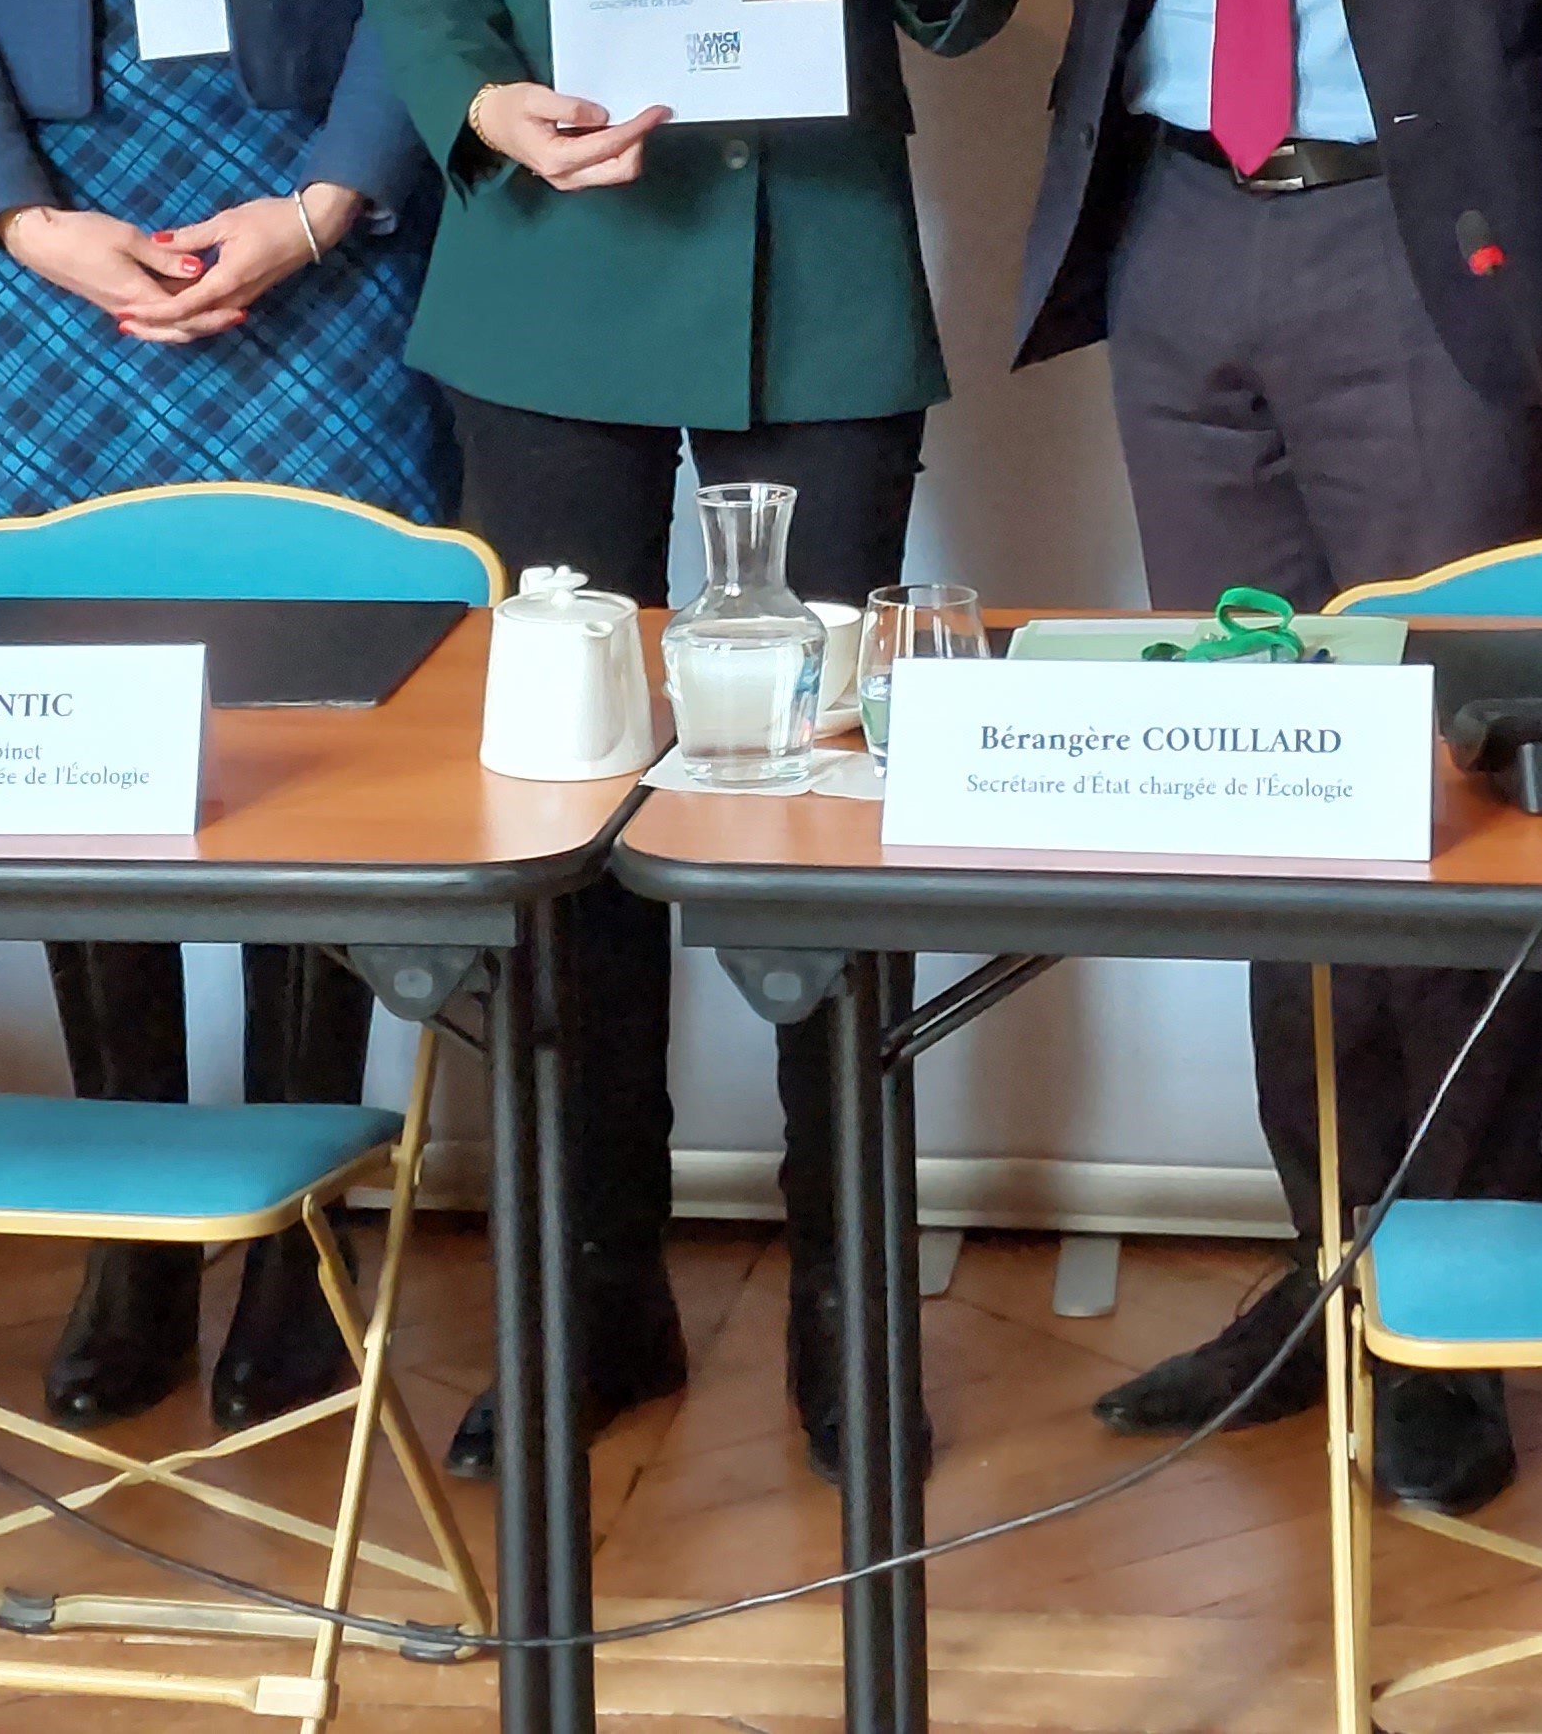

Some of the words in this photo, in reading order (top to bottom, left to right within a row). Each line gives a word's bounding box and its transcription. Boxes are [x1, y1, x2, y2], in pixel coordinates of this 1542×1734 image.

[980, 724, 1132, 758] Bérangère
[1142, 726, 1342, 754] COUILLARD
[24, 765, 48, 785] de
[53, 762, 150, 790] l'Écologie
[966, 773, 1067, 793] Secrétaire
[1073, 770, 1131, 795] d'État
[1138, 775, 1217, 800] chargée
[1224, 777, 1248, 796] de
[1256, 773, 1353, 803] l'Écologie
